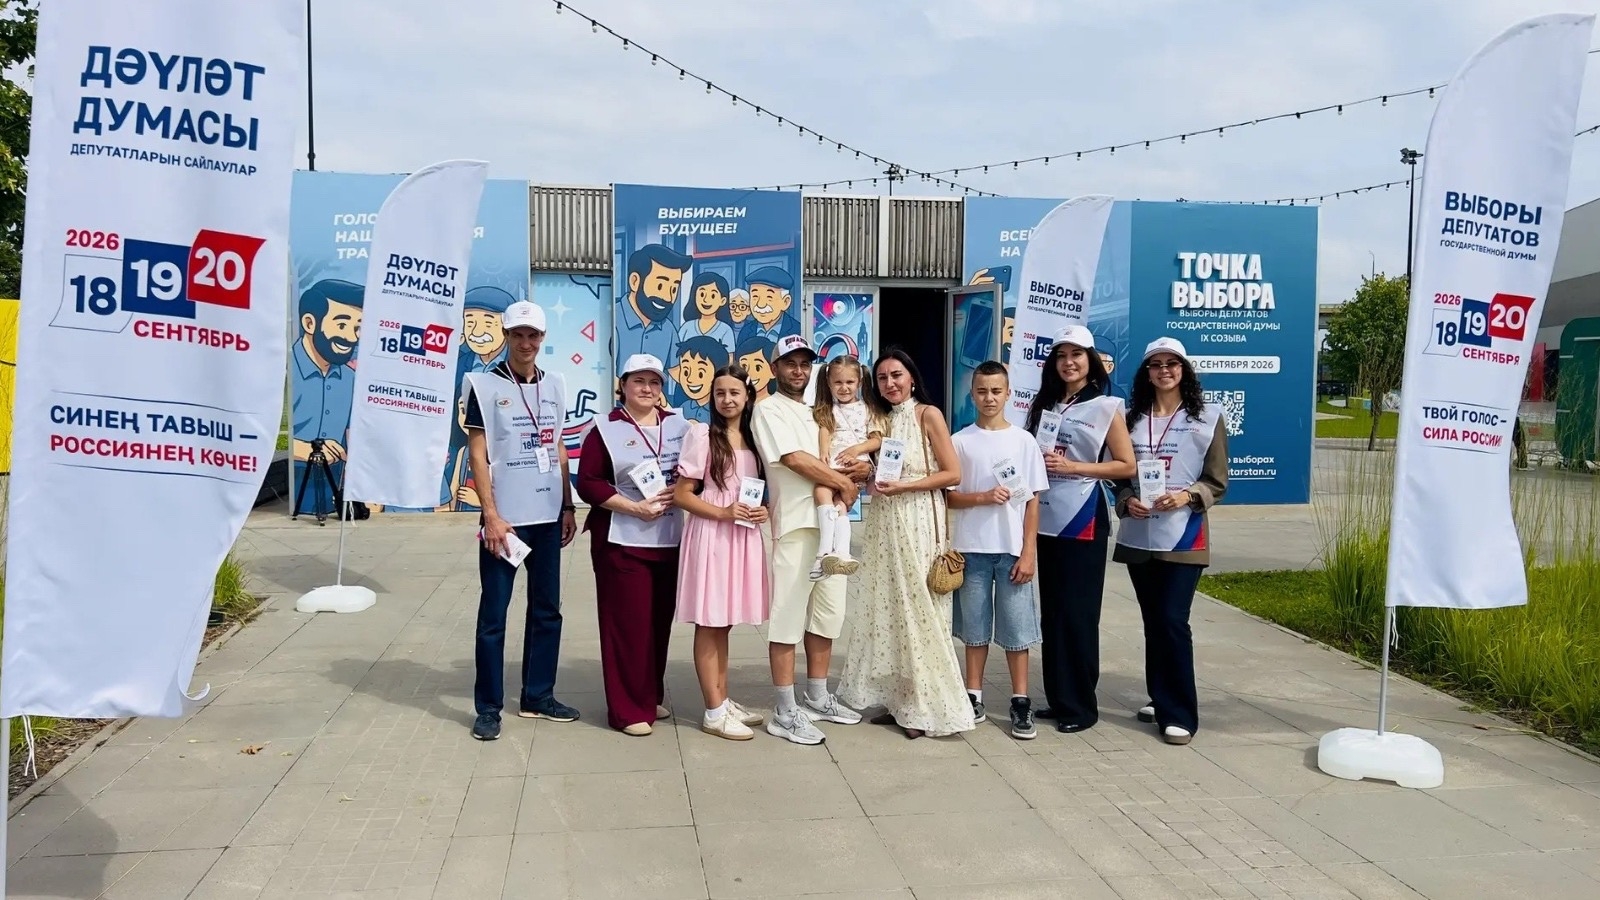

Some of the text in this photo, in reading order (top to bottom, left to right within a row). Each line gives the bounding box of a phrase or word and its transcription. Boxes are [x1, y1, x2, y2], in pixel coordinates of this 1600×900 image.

[81, 45, 266, 101] ДӘҮЛӘТ
[73, 96, 259, 151] ДУМАСЫ
[70, 143, 257, 177] ДЕПУТАТЛАРЫН САЙЛАУЛАР
[657, 206, 747, 219] ВЫБИРАЕМ
[1445, 191, 1542, 225] ВЫБОРЫ
[333, 213, 378, 226] ГОЛО
[659, 222, 738, 236] БУДУЩЕЕ!
[66, 229, 120, 251] 2026
[1442, 217, 1540, 247] ДЕПУТАТОВ
[337, 247, 369, 260] ТРА
[1000, 246, 1021, 257] НА
[1440, 239, 1537, 261] ГОСУДАРСТВЕННОЙ ДУМЫ
[387, 253, 458, 281] ДӘҮЛӘТ
[1178, 251, 1263, 280] ТОЧКА
[69, 247, 246, 316] 18 19 20
[384, 272, 456, 298] ДУМАСЫ
[1030, 280, 1084, 302] ВЫБОРЫ
[1028, 294, 1082, 313] ДЕПУТАТОВ
[1172, 281, 1276, 310] ВЫБОРА
[1434, 293, 1461, 306] 2026
[1026, 305, 1066, 317] ГОСУДАРСТВЕННОЙ
[1179, 309, 1269, 318] ВЫБОРЫ ДЕПУТАТОВ
[379, 320, 400, 329] 2026
[1166, 321, 1281, 332] ГОСУДАРСТВЕННОЙ ДУМЫ
[1435, 305, 1525, 346] 18 19 20
[133, 320, 250, 352] СЕНТЯБРЬ
[380, 329, 447, 353] 18 19 20
[1210, 334, 1247, 342] СОЗЫВА
[402, 354, 446, 370] СЕНТЯБРЬ
[1022, 347, 1034, 361] 18
[1462, 347, 1520, 366] СЕНТЯБРЯ
[1199, 360, 1248, 369] СЕНТЯБРЯ
[1250, 360, 1274, 369] 2026
[368, 384, 402, 398] СИНЕҢ
[404, 389, 437, 403] ТАВЫШ
[1014, 389, 1031, 400] ТВОЙ
[367, 396, 445, 414] РОССИЯНЕҢ КӨЧЕ!
[50, 405, 140, 433] СИНЕҢ
[146, 413, 233, 442] ТАВЫШ
[1422, 405, 1458, 421] ТВОЙ
[1462, 410, 1499, 426] ГОЛОС
[522, 441, 532, 450] 18
[541, 432, 553, 440] 20
[1423, 427, 1458, 441] СИЛА
[50, 434, 257, 473] РОССИЯНЕҢ КӨЧЕ!
[1233, 455, 1274, 466] выборах
[1228, 468, 1277, 476] tarstan.ru
